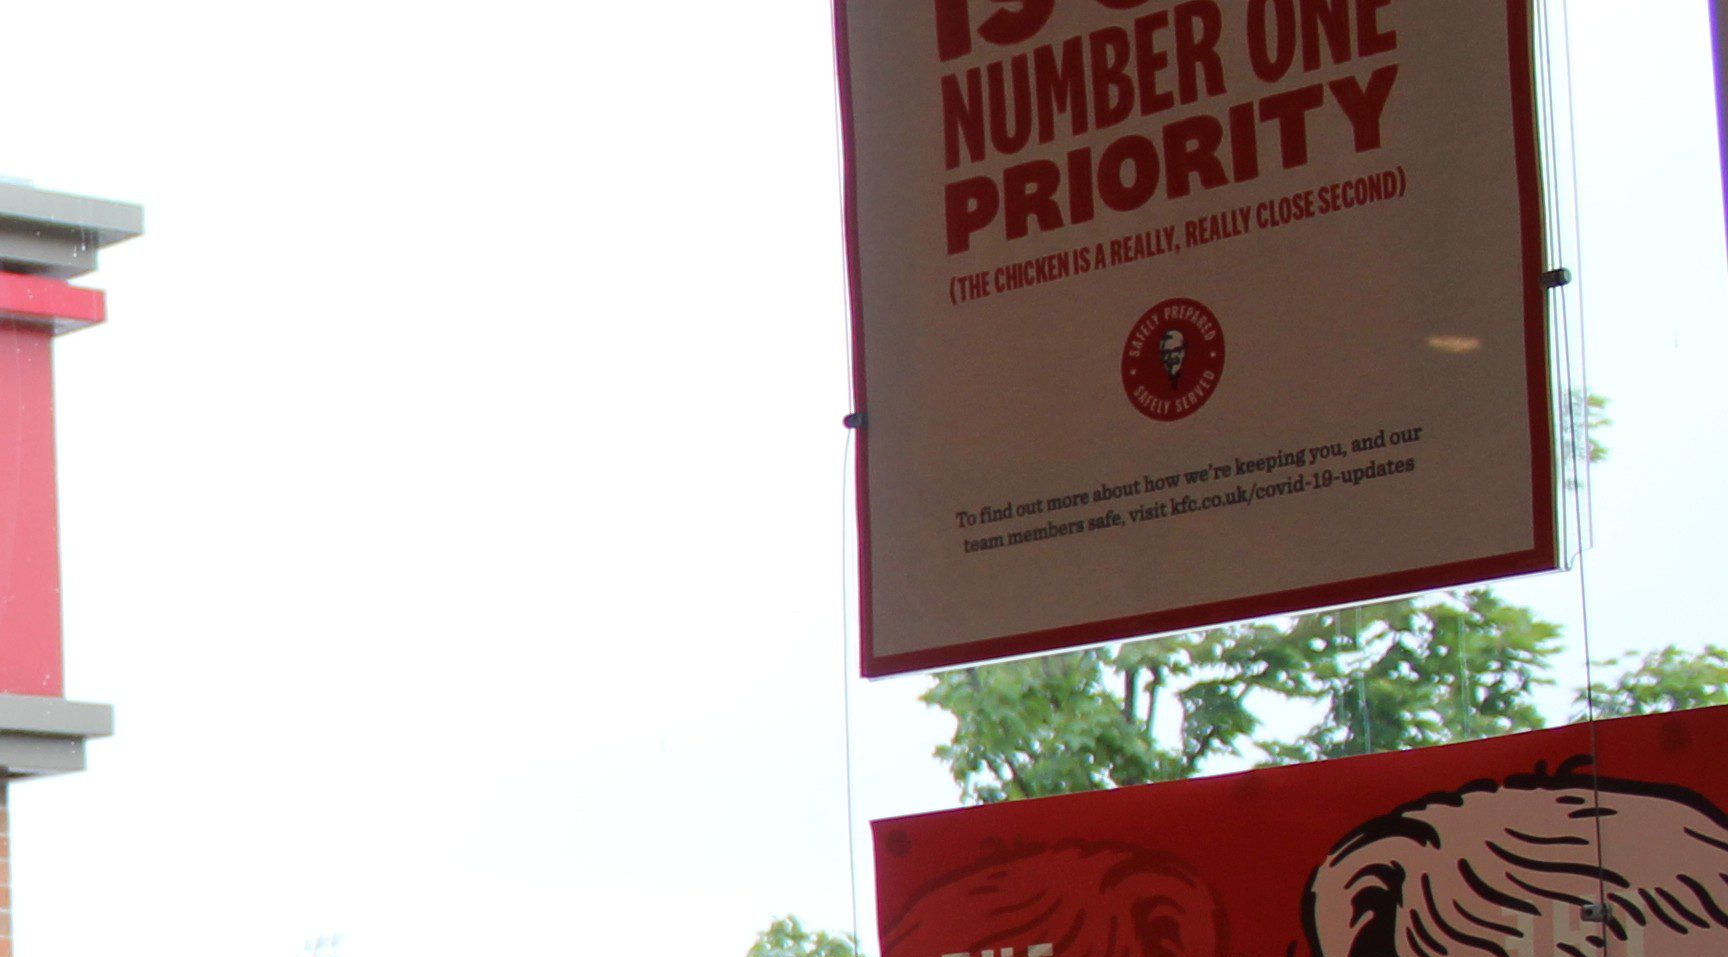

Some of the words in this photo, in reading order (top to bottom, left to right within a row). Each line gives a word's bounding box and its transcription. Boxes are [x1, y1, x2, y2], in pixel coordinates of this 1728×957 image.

[941, 0, 1227, 171] NUMBER
[1246, 0, 1398, 83] ONE
[945, 64, 1399, 256] PRIORITY
[949, 276, 991, 305] (THE
[994, 250, 1069, 293] CHICKEN
[1073, 246, 1091, 275] IS
[1095, 242, 1106, 270] A
[1110, 225, 1180, 266] REALLY,
[1185, 206, 1251, 248] REALLY
[1256, 190, 1315, 229] CLOSE
[1318, 165, 1406, 214] SECOND)
[1129, 313, 1160, 358] SAFELY
[1164, 304, 1217, 341] PREPARED
[1133, 386, 1171, 414] SAFELY
[1175, 370, 1215, 413] SERVED
[956, 511, 977, 528] To
[980, 502, 1013, 524] find
[1016, 500, 1044, 518] out
[1047, 491, 1090, 511] more
[1093, 480, 1141, 502] about
[1145, 475, 1180, 493] how
[1235, 448, 1306, 475] keeping
[1309, 443, 1347, 466] you,
[1351, 430, 1385, 453] and
[1389, 427, 1423, 445] our
[964, 535, 1004, 554] team
[1008, 519, 1085, 546] members
[1087, 509, 1126, 534] safe,
[1129, 501, 1167, 523] visit
[1171, 456, 1416, 516] kfc.co.uk/covid-19-updates
